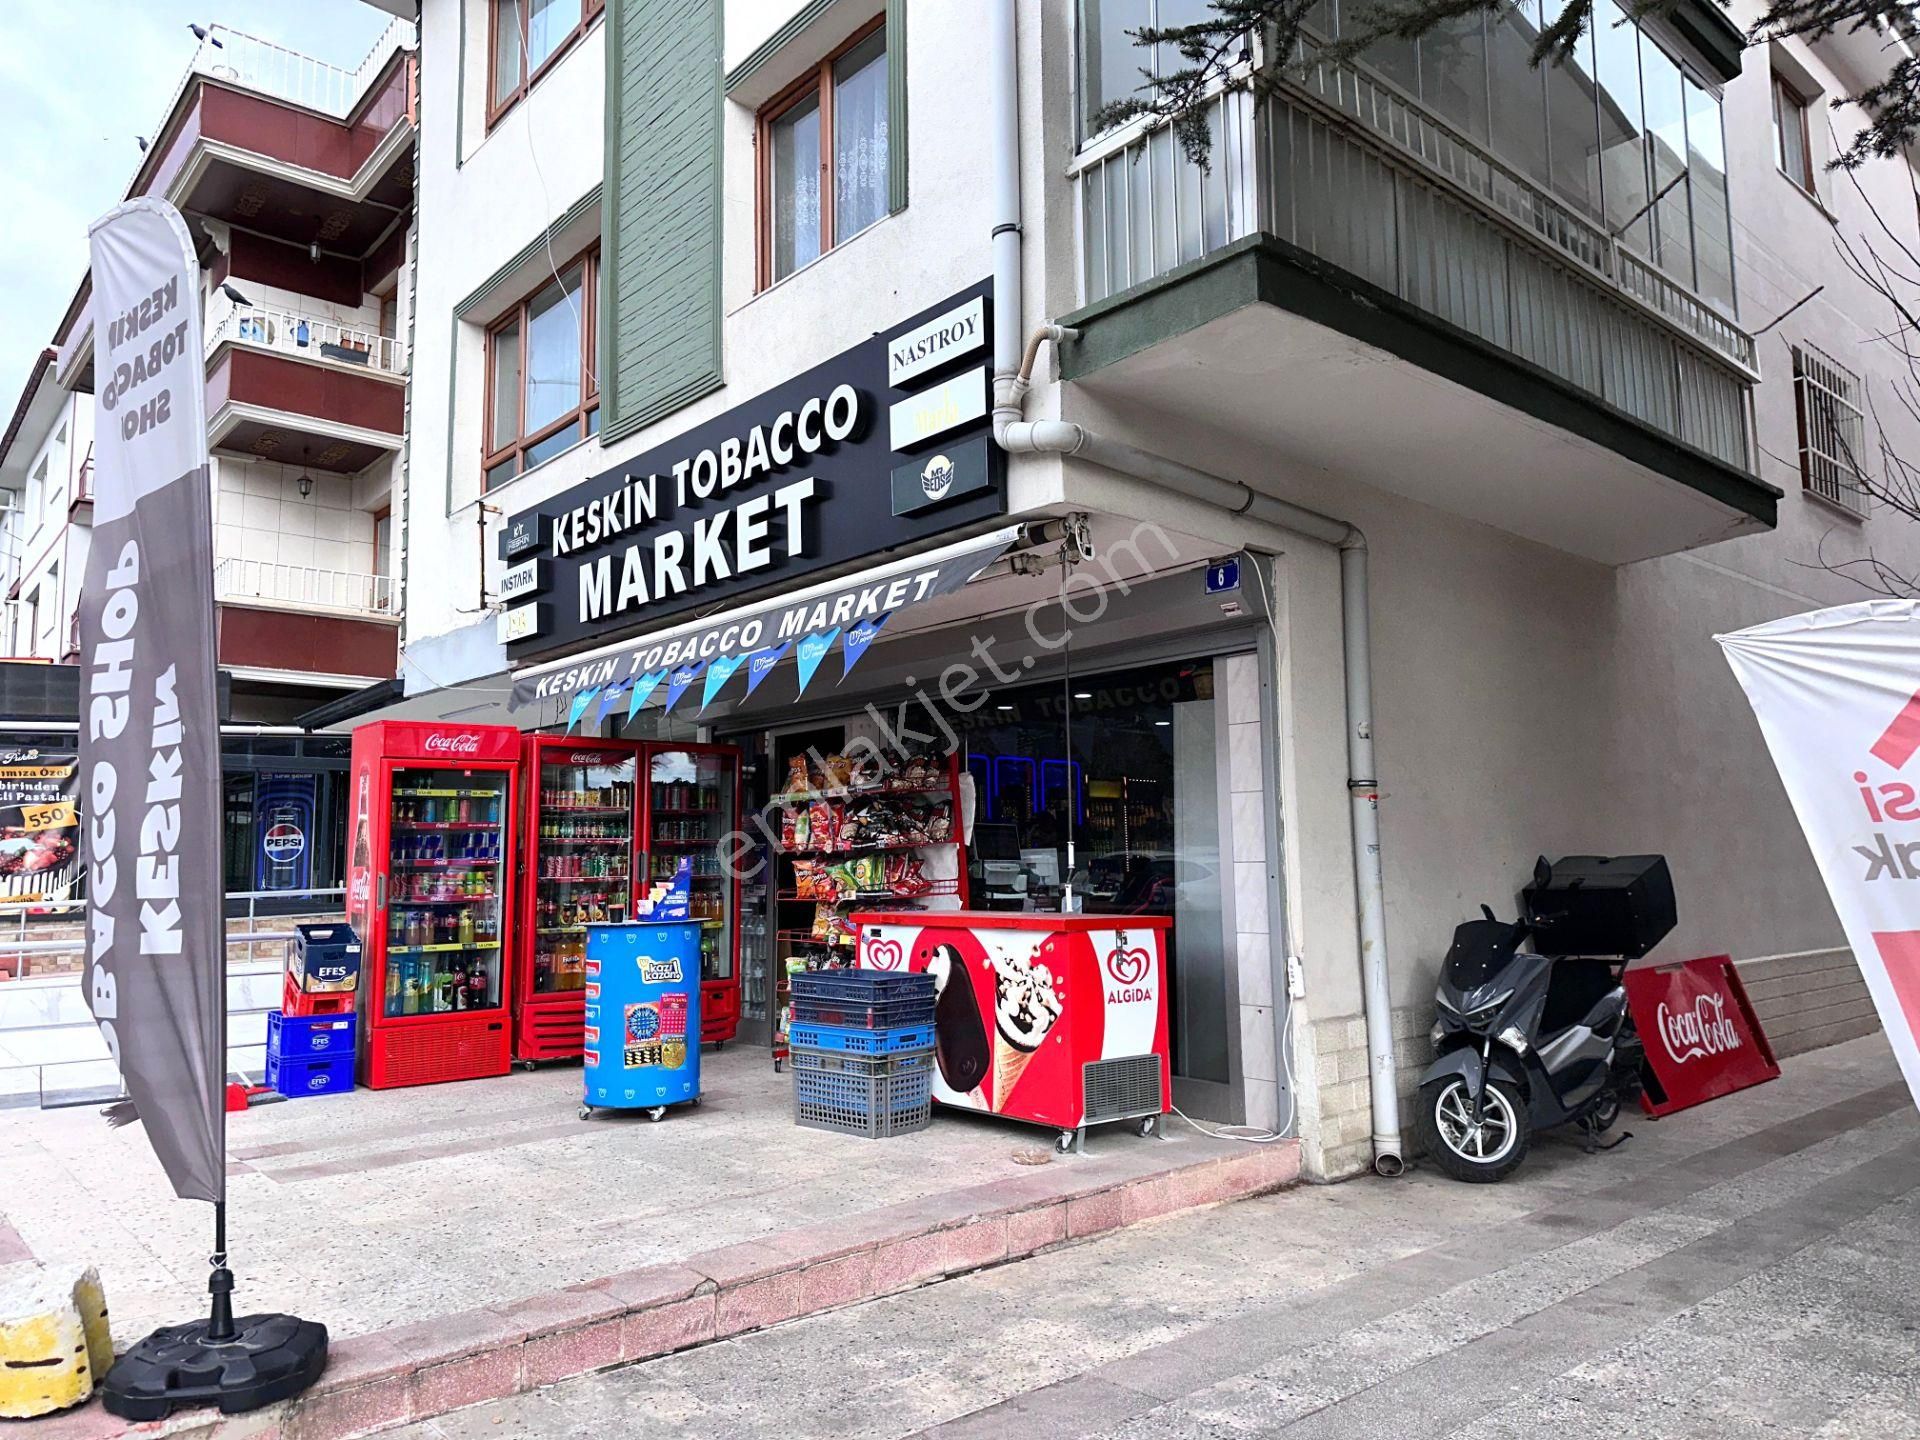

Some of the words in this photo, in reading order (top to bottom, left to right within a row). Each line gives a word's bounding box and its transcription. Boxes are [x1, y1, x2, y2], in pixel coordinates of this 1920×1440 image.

[893, 313, 978, 371] NASTROY
[552, 473, 657, 558] KESKİN
[672, 384, 858, 508] TOBACCO
[930, 466, 943, 477] MR
[930, 473, 946, 492] EDS
[579, 476, 814, 624] MARKET
[501, 567, 534, 594] INSTARK
[1218, 568, 1225, 586] 6
[629, 619, 763, 674] TOBACCO
[777, 568, 940, 639] MARKET
[425, 733, 480, 752] Coca-Cola
[570, 752, 601, 764] Coca-Cola
[0, 781, 59, 790] birinden
[16, 792, 76, 801] Pastalar
[266, 838, 302, 847] PEPSI
[318, 966, 346, 977] EFES
[1657, 992, 1743, 1063] Coca-Cola
[312, 1037, 329, 1045] EFES
[311, 1078, 327, 1086] EFES
